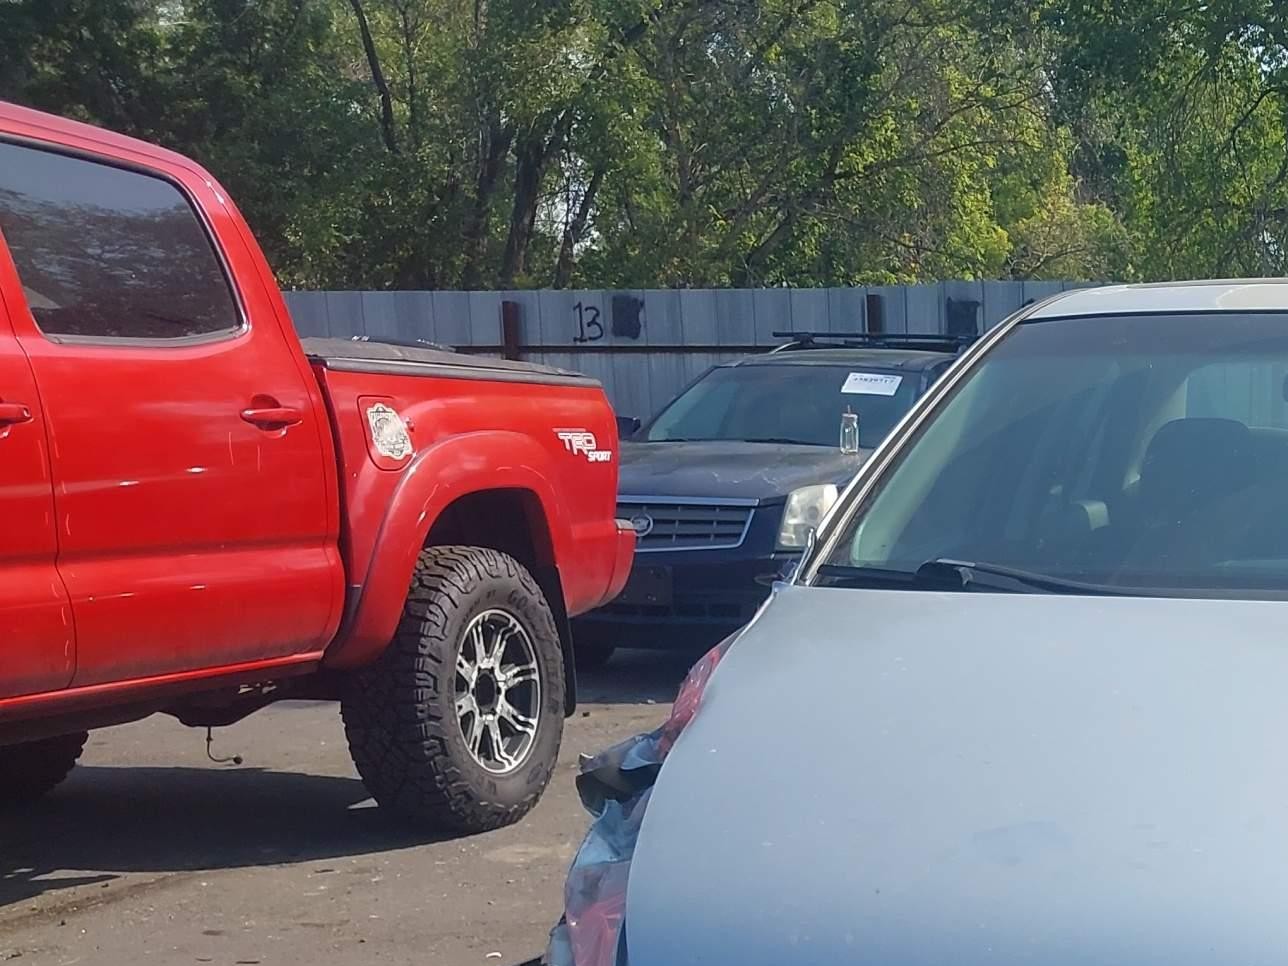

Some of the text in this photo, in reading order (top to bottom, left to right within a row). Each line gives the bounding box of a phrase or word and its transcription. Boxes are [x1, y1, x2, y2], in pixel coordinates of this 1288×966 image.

[572, 300, 604, 343] 13
[557, 432, 597, 456] TRD
[587, 450, 612, 463] SPORT
